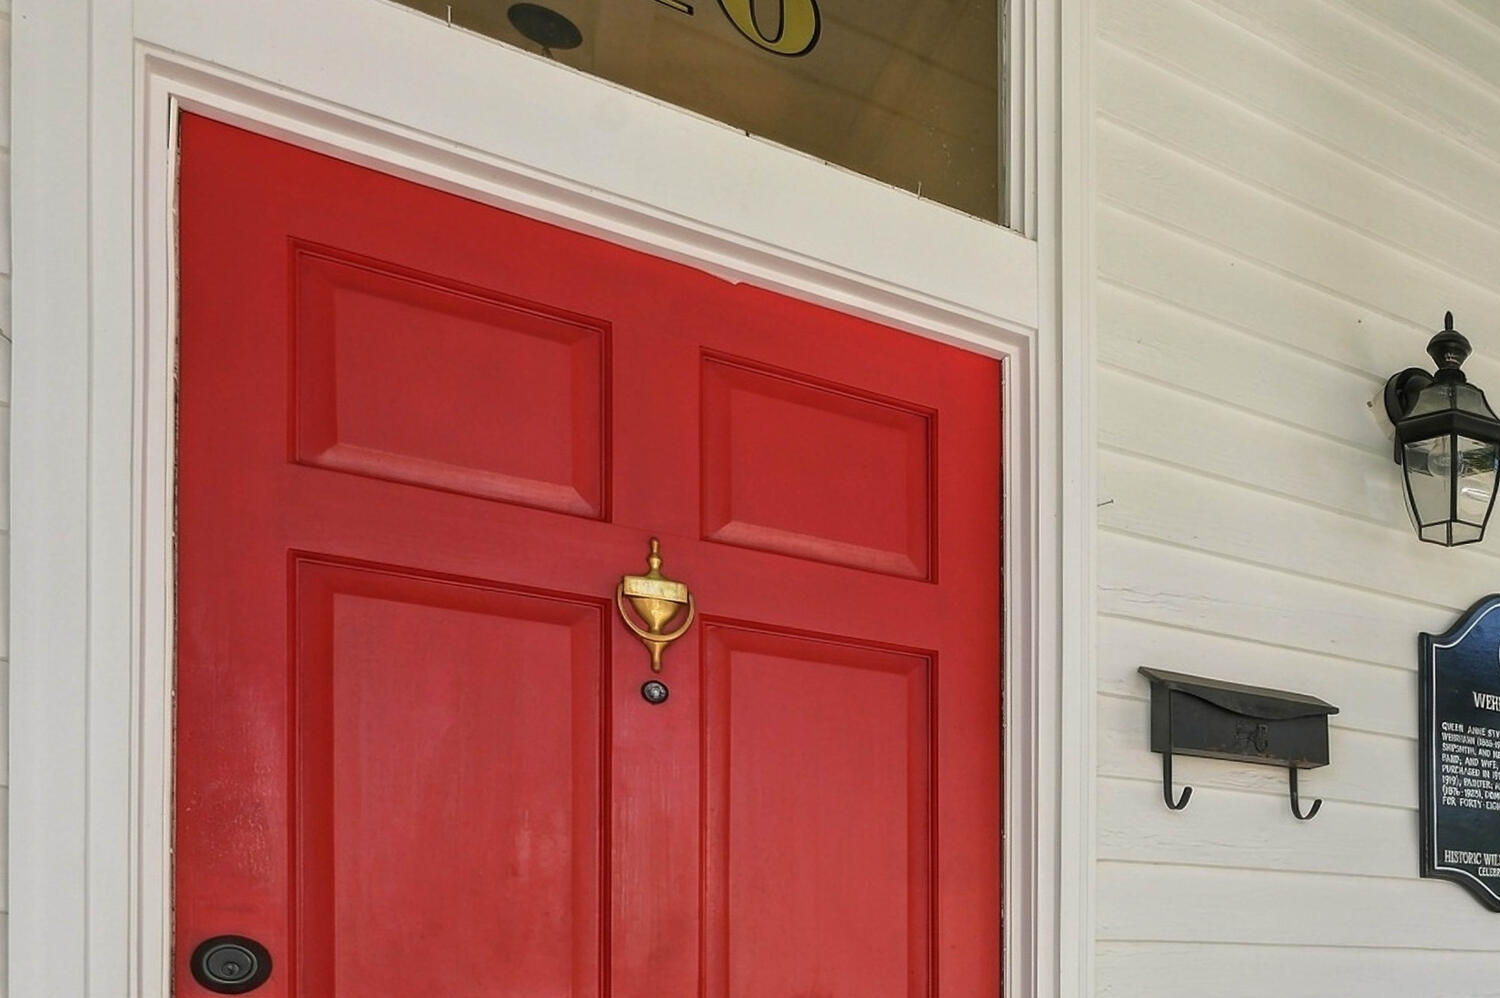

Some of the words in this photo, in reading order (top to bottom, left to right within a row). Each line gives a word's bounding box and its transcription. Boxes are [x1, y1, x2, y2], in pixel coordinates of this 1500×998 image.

[1442, 722, 1463, 732] QUEEN
[1478, 748, 1491, 758] AND
[1464, 757, 1479, 767] AND
[1442, 796, 1457, 806] FOR
[1444, 849, 1482, 865] HISTORIC
